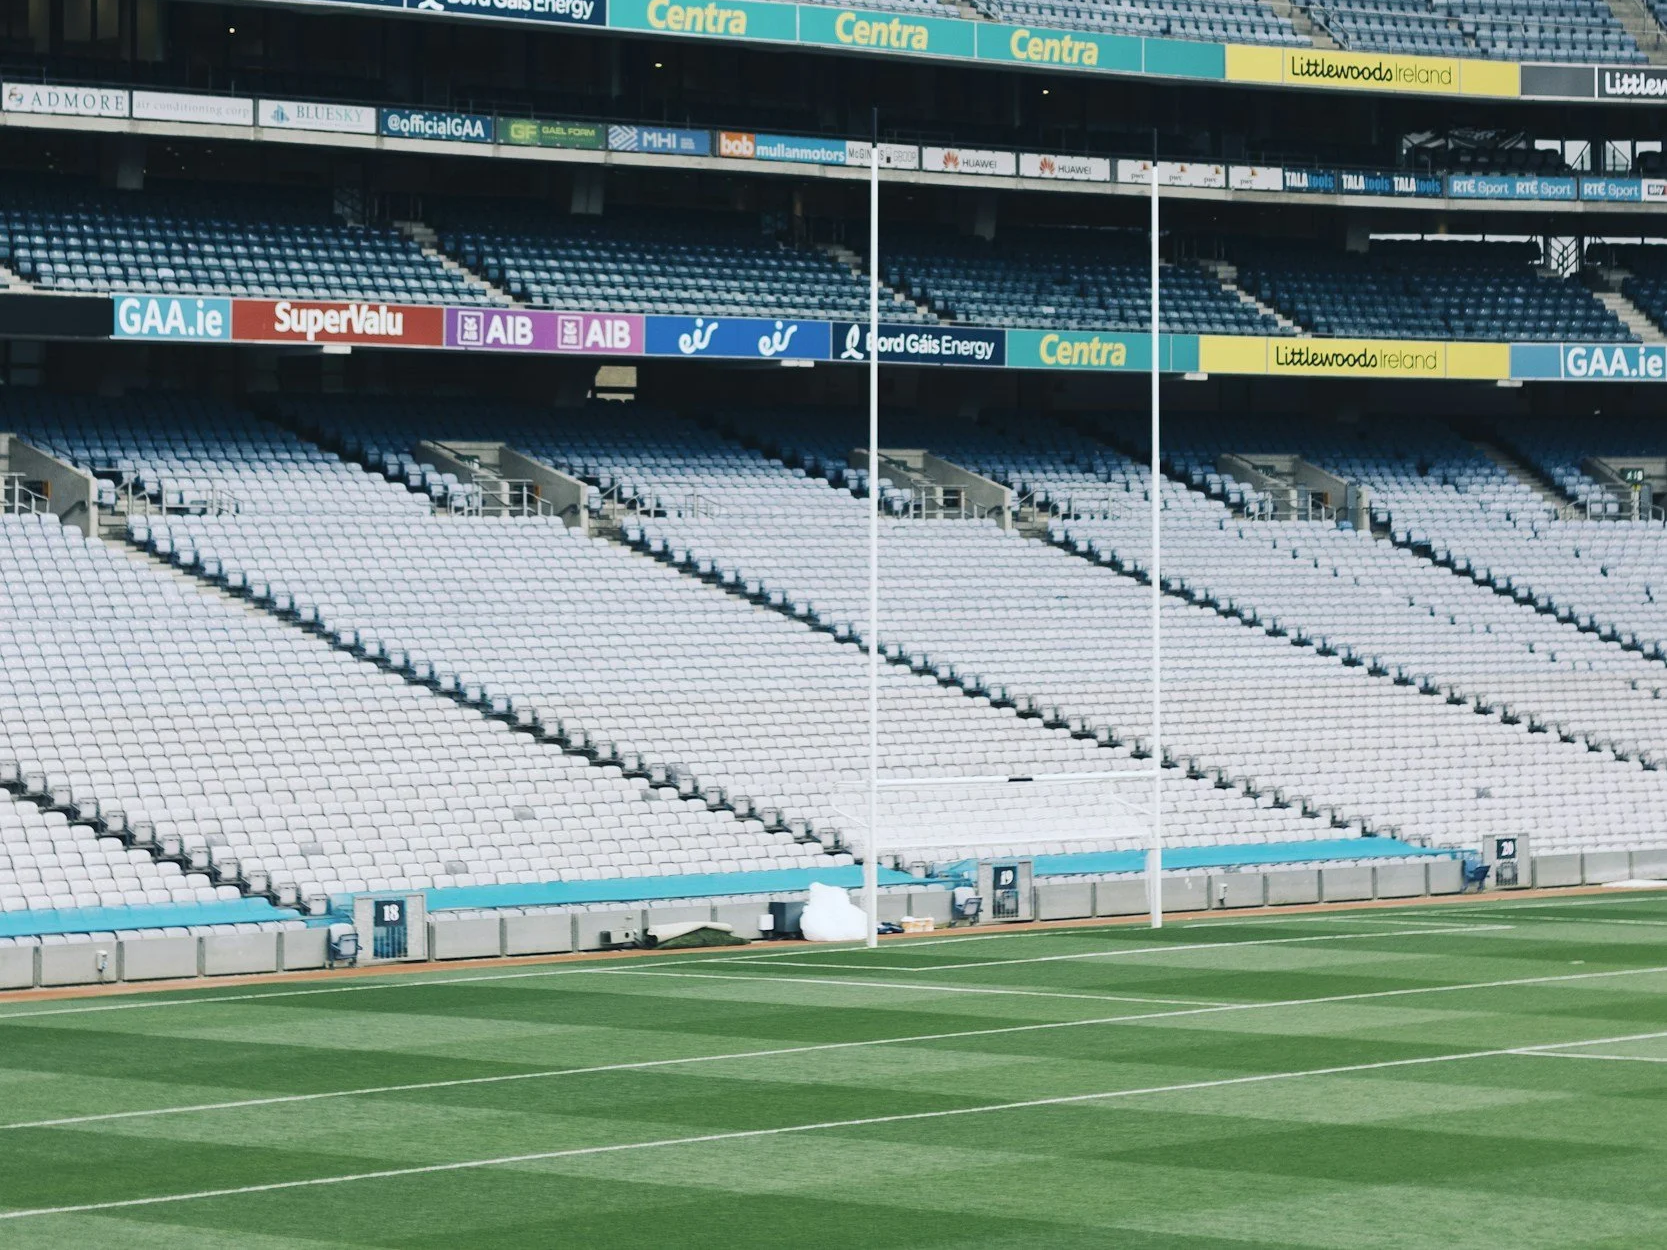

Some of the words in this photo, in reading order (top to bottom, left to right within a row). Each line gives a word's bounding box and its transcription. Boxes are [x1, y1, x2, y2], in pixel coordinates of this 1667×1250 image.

[835, 11, 929, 51] Centra
[1010, 29, 1099, 66] Centra
[1291, 56, 1393, 82] Littlewoods
[1395, 62, 1452, 86] Ireland
[31, 91, 124, 111] ADMORE
[154, 101, 222, 116] conditioning
[296, 105, 364, 122] BLUESKY
[388, 114, 485, 137] @officialGAA
[511, 123, 537, 139] GF
[541, 126, 567, 135] GAEL
[567, 128, 595, 136] FORM
[643, 131, 677, 149] MHI
[720, 132, 754, 156] bob
[962, 158, 997, 169] HUAWEI
[1058, 165, 1092, 175] HUAWEI
[1131, 173, 1144, 181] pwc
[1169, 174, 1183, 182] pwc
[1204, 176, 1217, 184] pwc
[1240, 178, 1253, 186] pwc
[1478, 181, 1509, 196] Sport
[1541, 182, 1572, 197] Sport
[1608, 183, 1638, 199] Sport
[118, 297, 223, 337] GAA.ie
[273, 301, 404, 341] SuperValu
[486, 315, 534, 346] AIB
[585, 319, 631, 349] AIB
[678, 318, 719, 354] eir
[758, 321, 798, 357] eir
[906, 333, 940, 354] Gáis
[941, 335, 995, 360] Energy
[1039, 333, 1127, 367] Centra
[1275, 345, 1378, 369] Littlewoods
[1379, 349, 1437, 370] Ireland
[1566, 346, 1663, 378] GAA.ie
